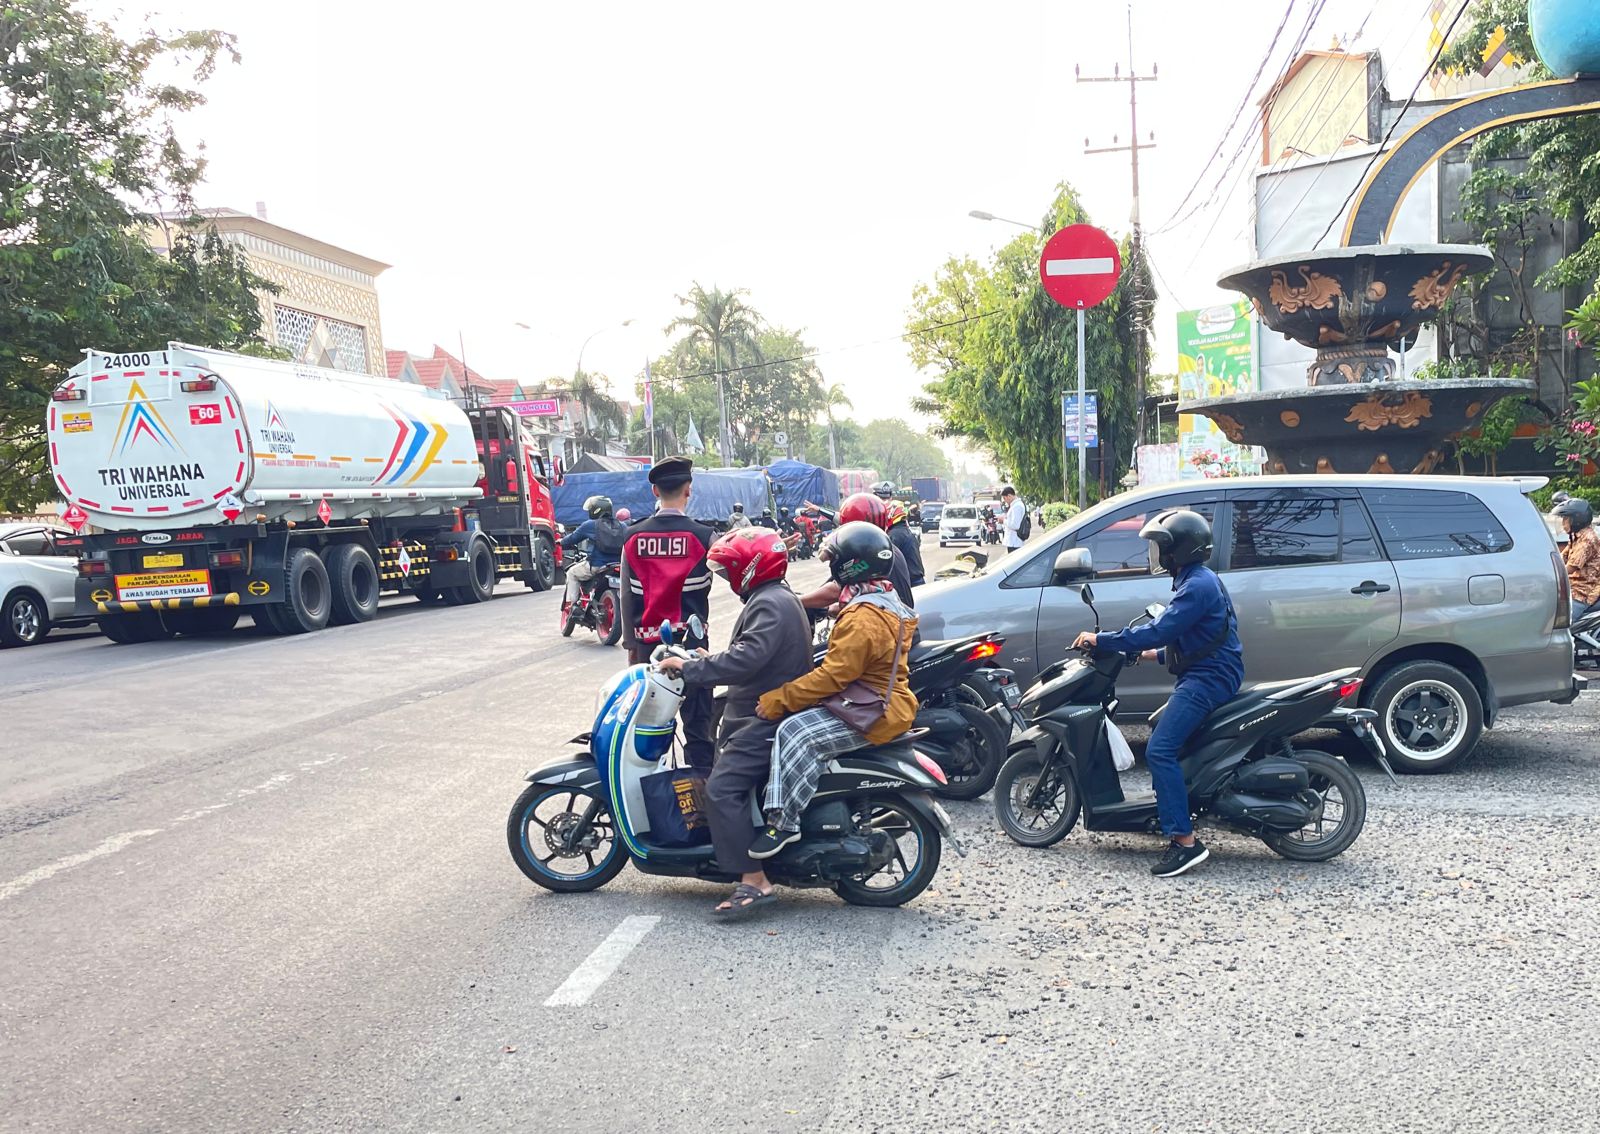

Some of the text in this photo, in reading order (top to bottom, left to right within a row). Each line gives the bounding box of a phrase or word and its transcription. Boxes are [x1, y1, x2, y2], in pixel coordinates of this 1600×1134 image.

[103, 353, 150, 369] 24000
[199, 407, 214, 419] 60
[260, 429, 296, 443] TRI WAHANA
[268, 443, 293, 454] UNIVERSAL
[98, 463, 205, 486] TRI WAHANA
[118, 483, 190, 500] UNIVERSAL
[116, 536, 138, 545] JAGA
[637, 537, 687, 556] POLISI
[145, 589, 169, 597] MUDAH
[170, 587, 205, 596] TERBAKAR
[1068, 707, 1093, 718] HONDA
[856, 780, 906, 790] Scoopy
